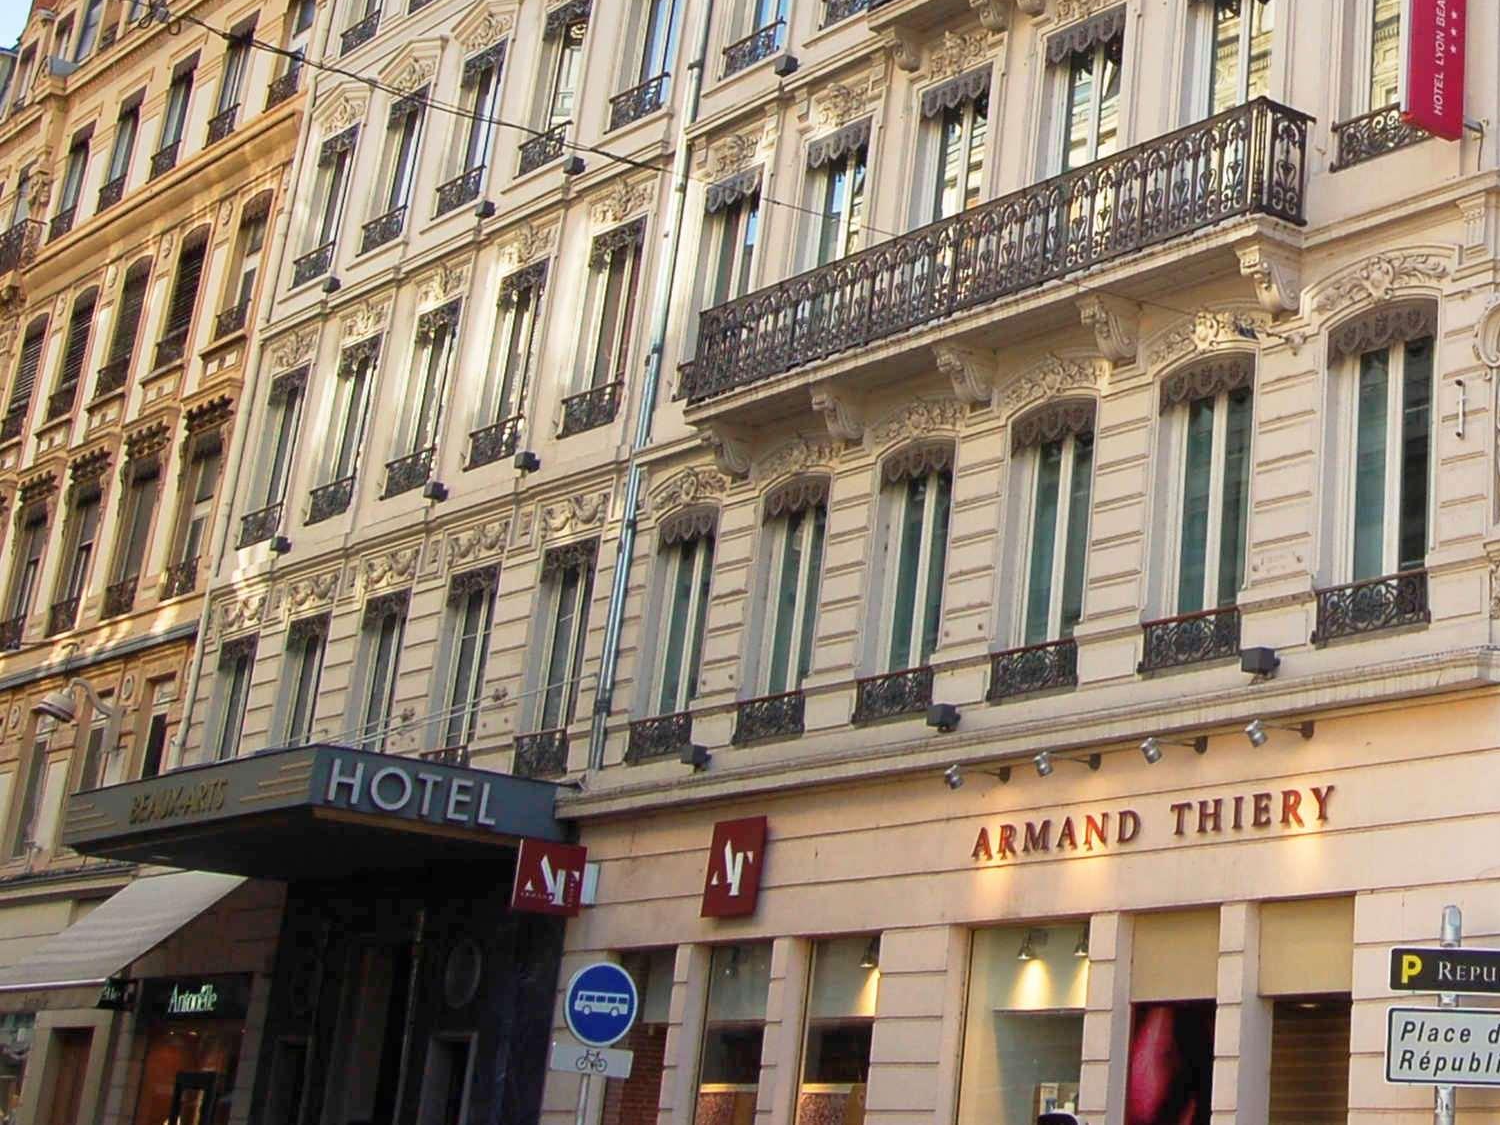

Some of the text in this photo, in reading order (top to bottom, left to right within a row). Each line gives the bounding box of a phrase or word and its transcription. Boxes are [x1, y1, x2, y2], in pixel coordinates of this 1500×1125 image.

[1435, 31, 1446, 66] LYON
[1434, 73, 1445, 116] HOTEL
[327, 758, 497, 826] HOTEL
[971, 785, 1336, 861] ARMAND THIERY
[1401, 954, 1424, 984] P
[1400, 1020, 1472, 1043] Place
